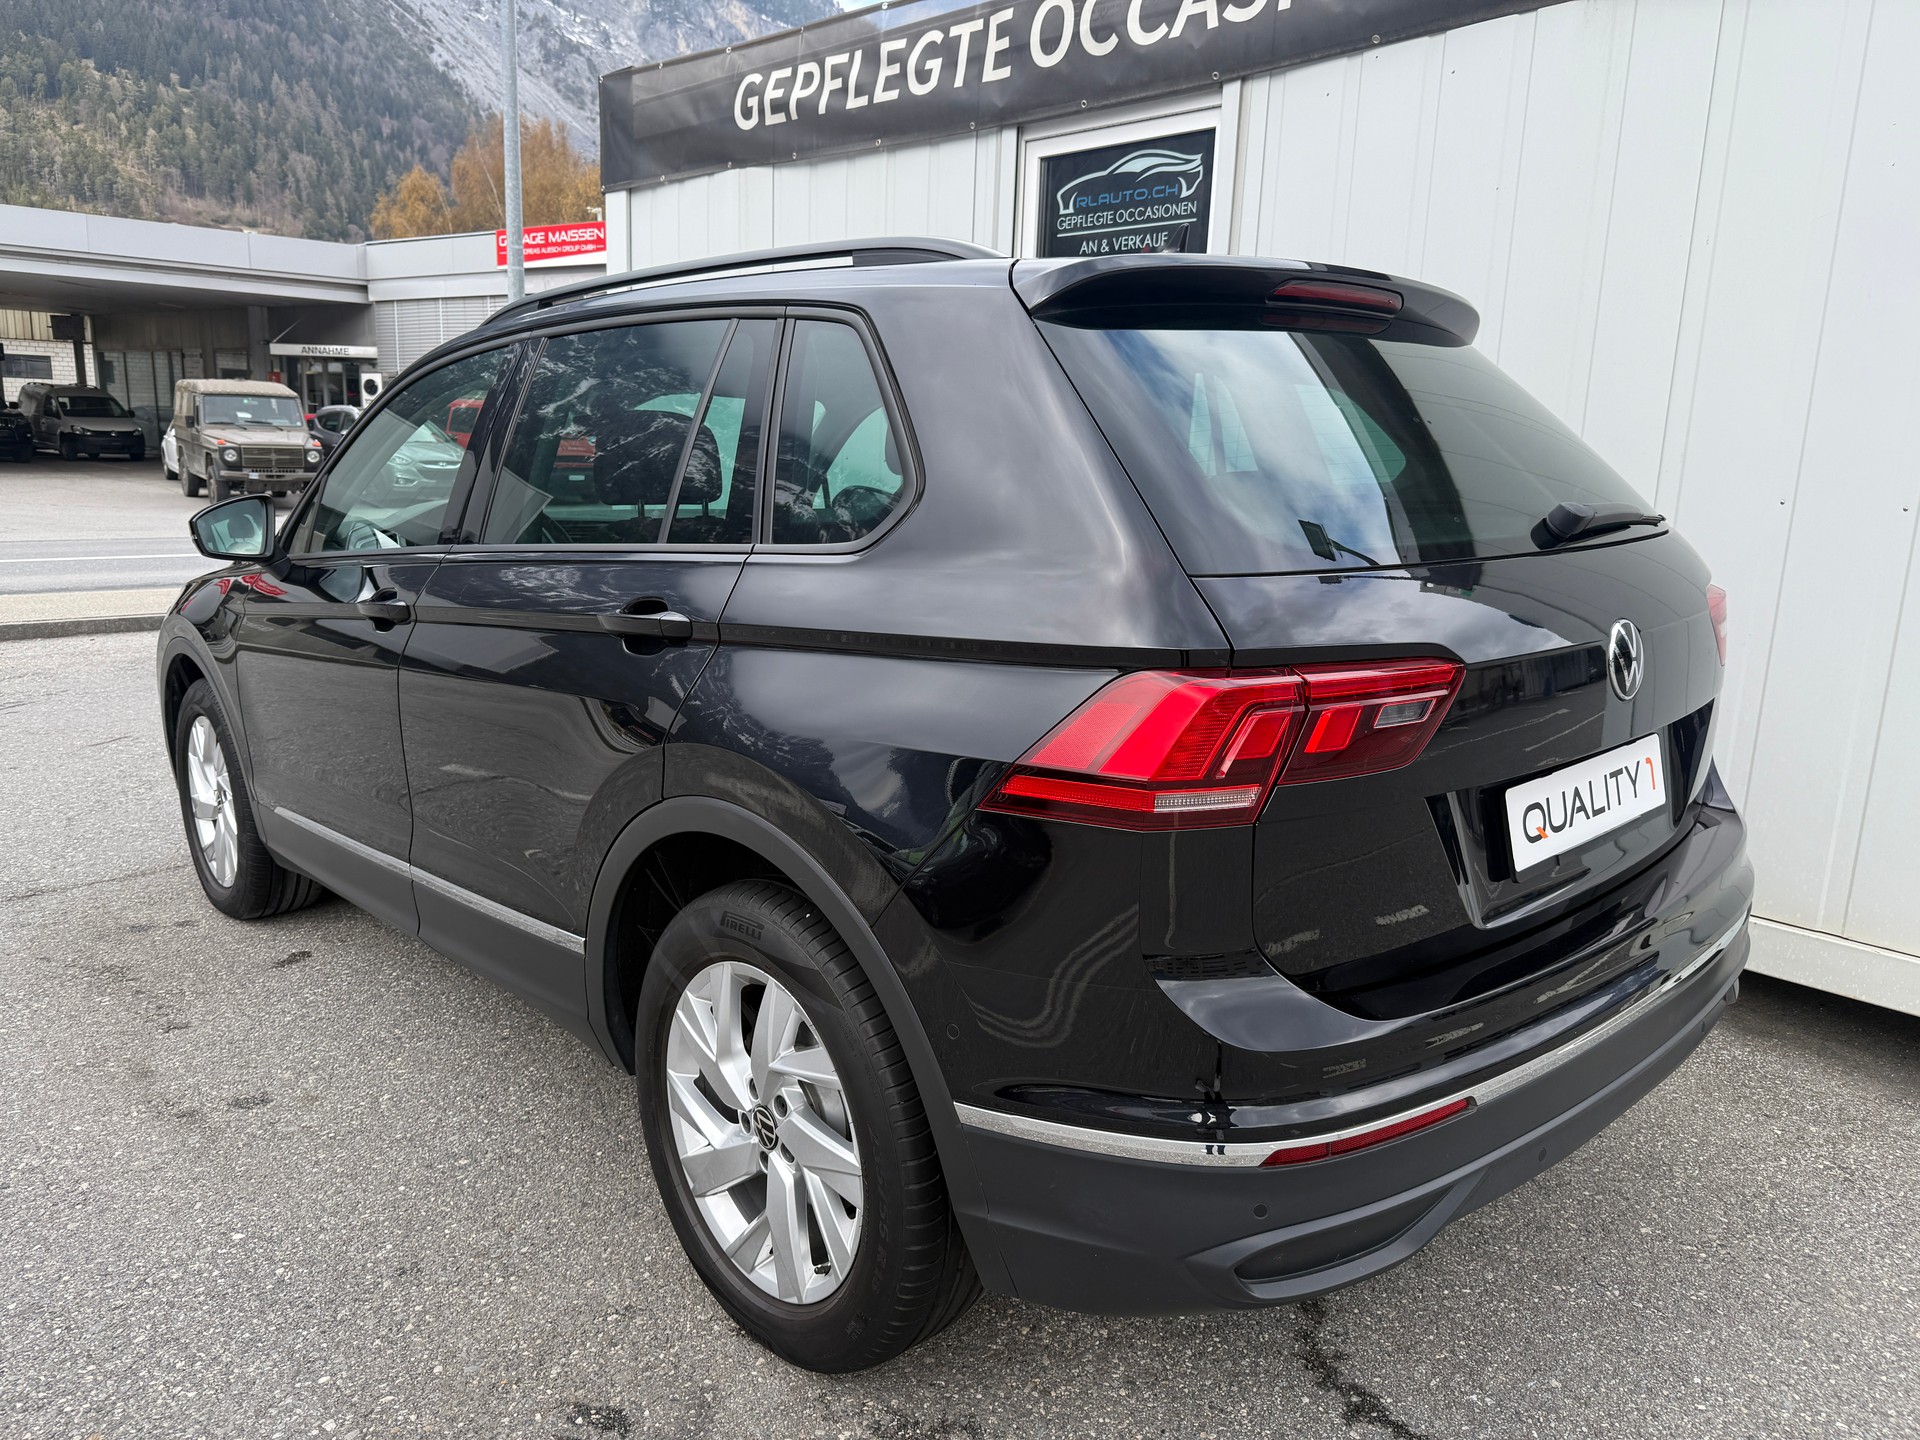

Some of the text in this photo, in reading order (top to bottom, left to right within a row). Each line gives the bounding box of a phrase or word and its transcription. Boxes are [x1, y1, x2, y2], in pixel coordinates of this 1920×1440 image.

[734, 0, 1292, 130] GEPFLEGTE OCC
[1076, 184, 1179, 208] RLAUTO.CH
[1057, 201, 1197, 230] GEPFLEGTE OCCASIONEN
[498, 227, 605, 246] GAGE MAISSEN
[1079, 232, 1169, 255] AN & VERKAUF
[301, 346, 350, 356] ANNAHME
[720, 910, 765, 940] PIRELLI
